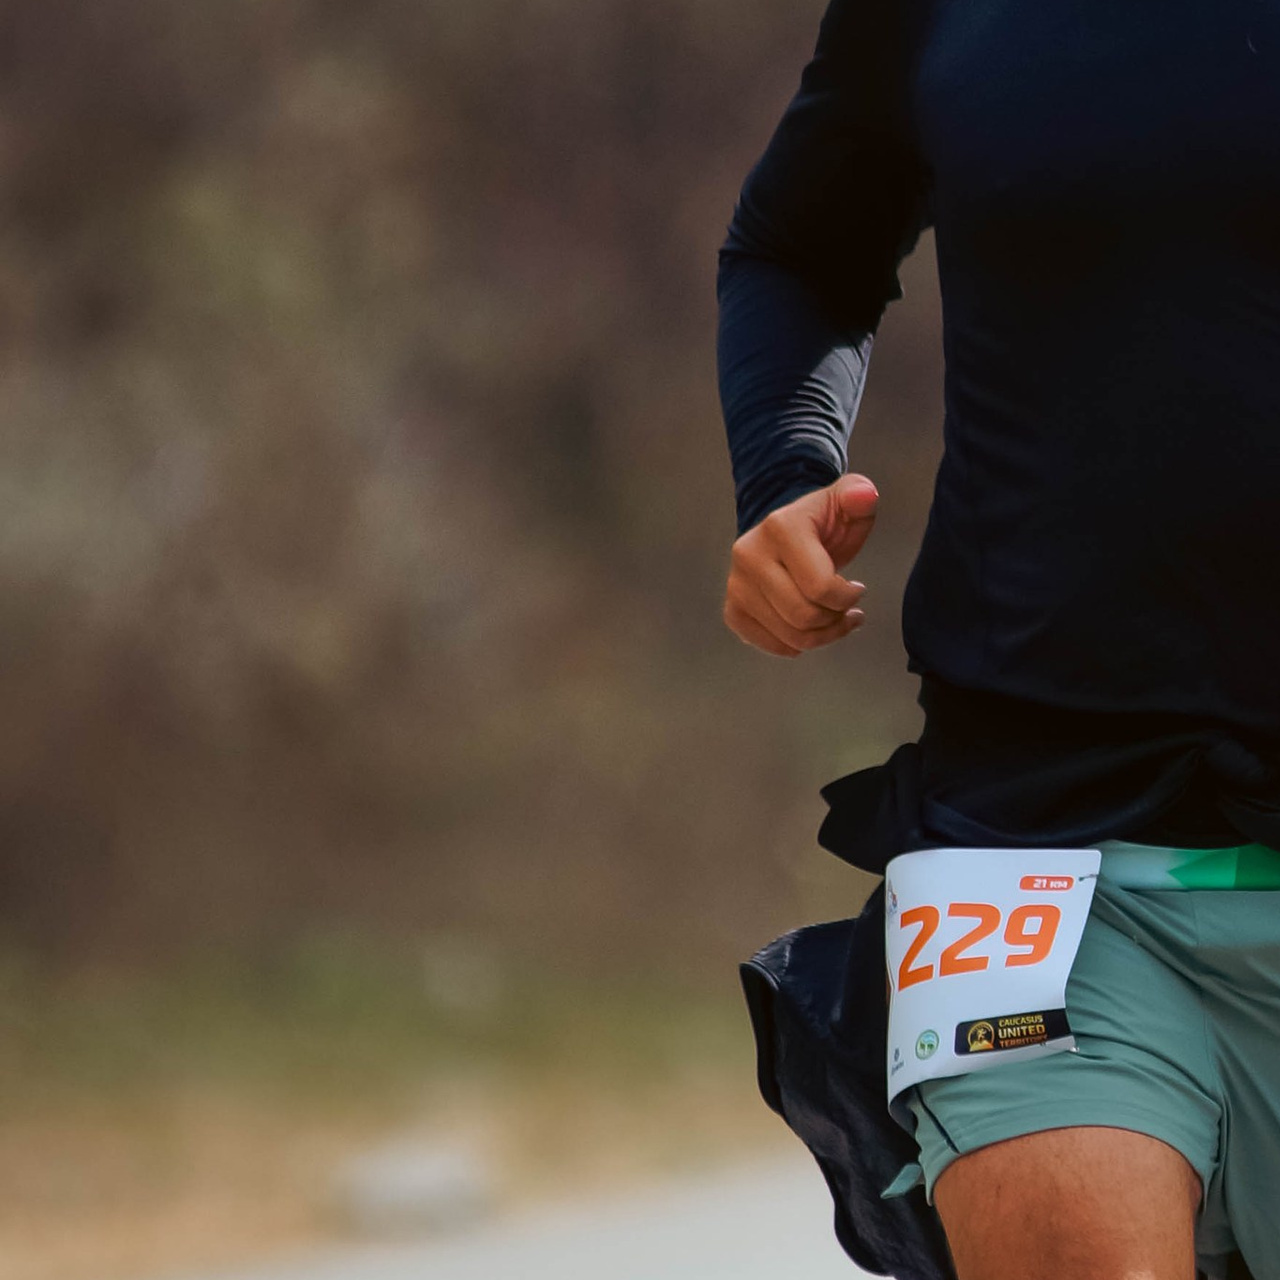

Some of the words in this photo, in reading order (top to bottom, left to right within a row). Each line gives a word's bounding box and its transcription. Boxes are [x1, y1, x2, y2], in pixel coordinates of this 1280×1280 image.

[1033, 878, 1047, 889] 21
[898, 902, 1061, 992] 229
[998, 1014, 1044, 1028] CAUCASUS
[998, 1024, 1046, 1039] UNITED
